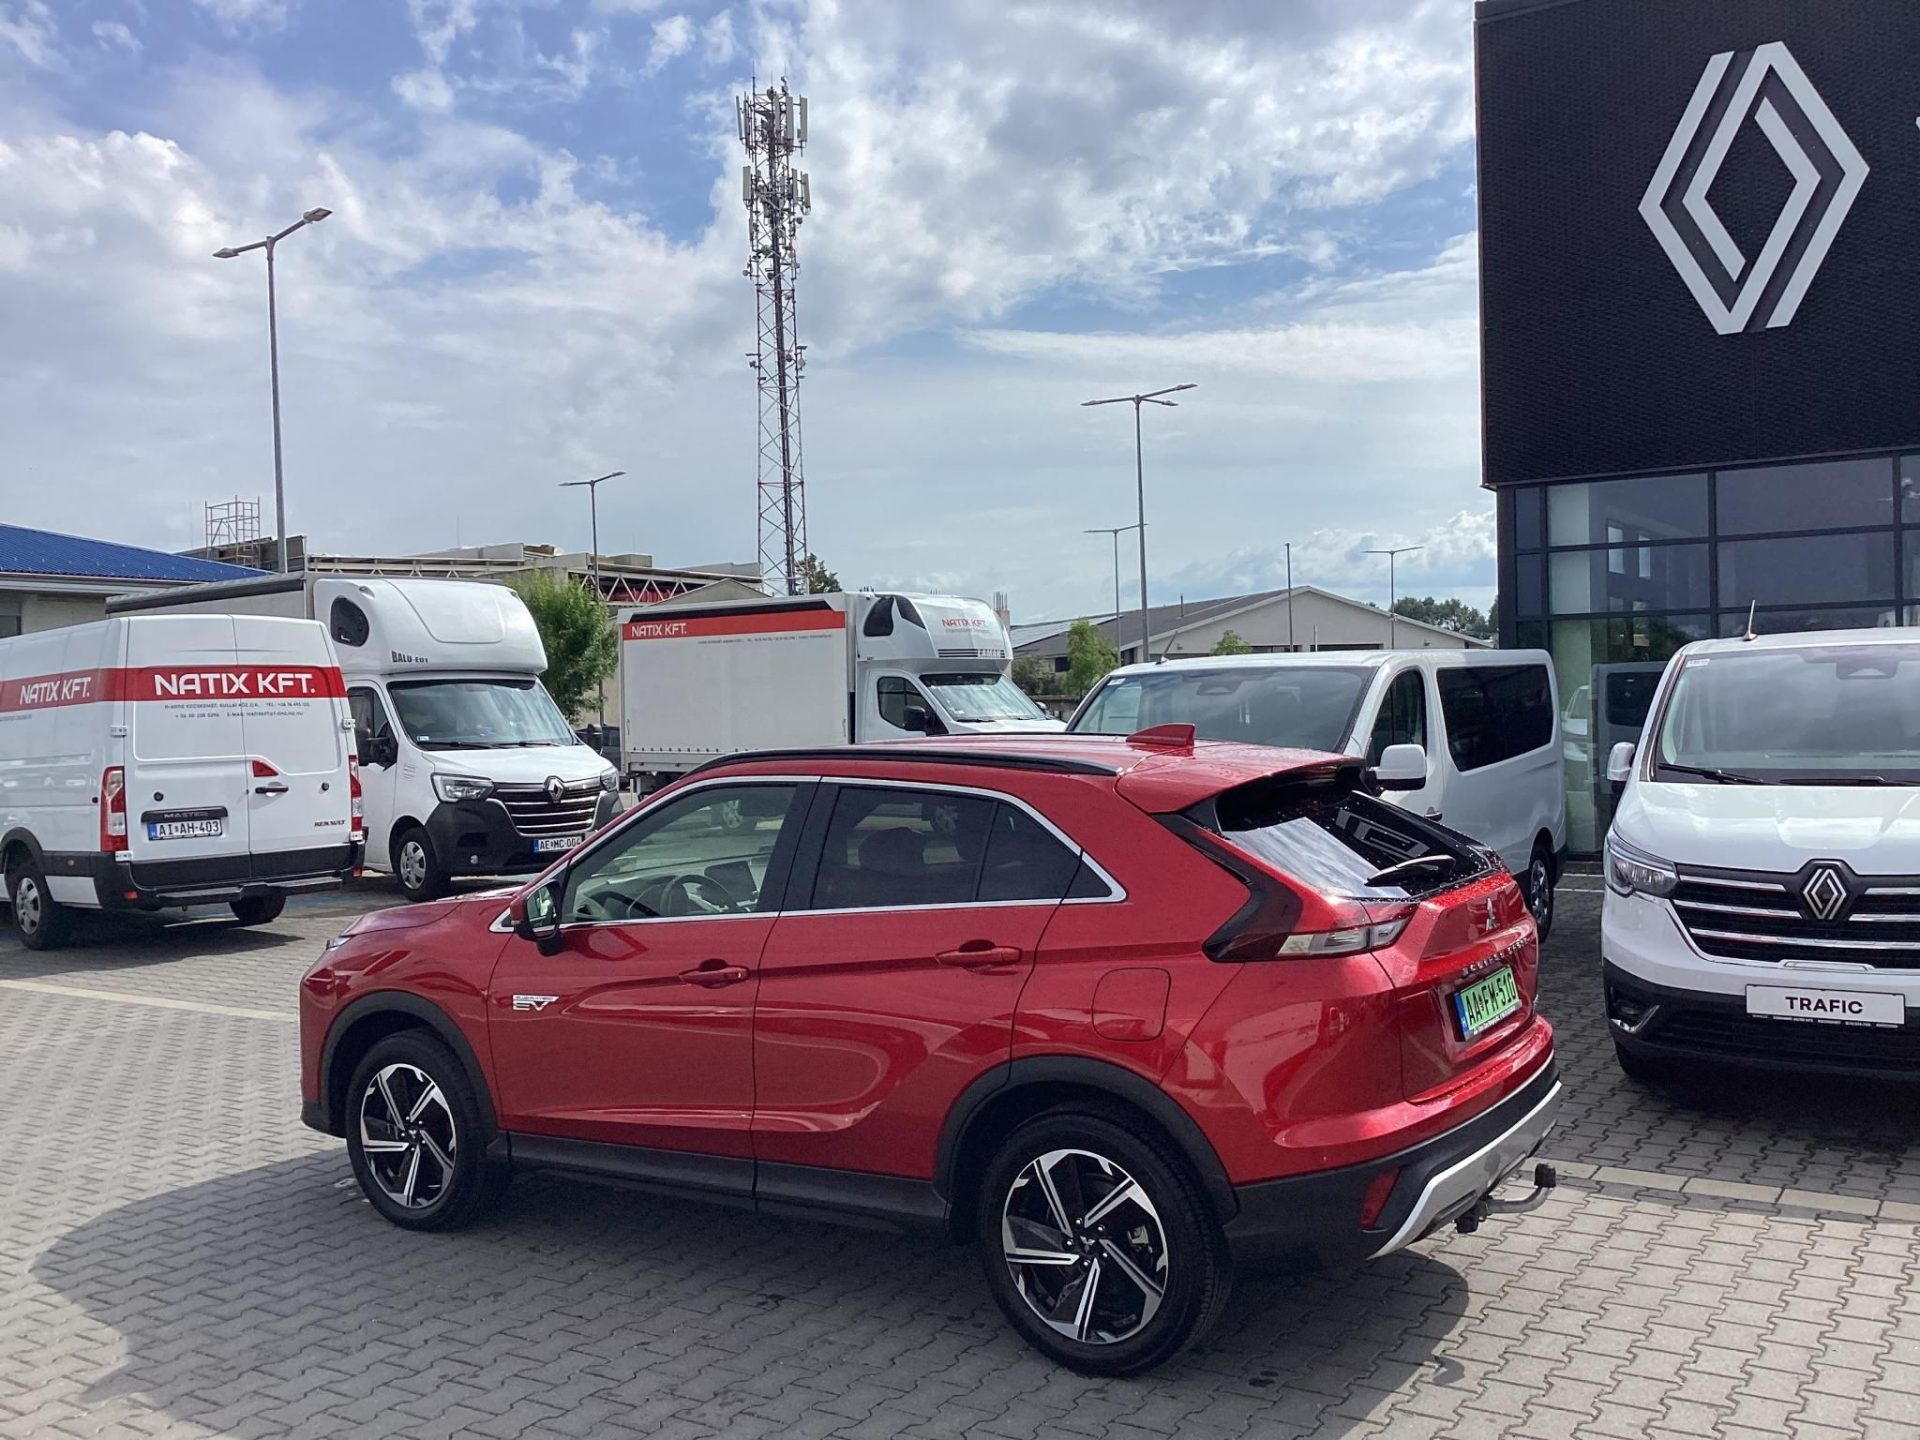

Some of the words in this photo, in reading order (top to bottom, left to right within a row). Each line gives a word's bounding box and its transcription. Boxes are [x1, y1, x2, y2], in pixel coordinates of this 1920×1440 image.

[631, 624, 662, 637] NATIX
[665, 623, 687, 635] KFT.
[20, 681, 60, 704] NATIX
[61, 677, 91, 700] KFT.
[154, 673, 250, 695] NATIX
[257, 672, 315, 694] KFT.
[1785, 996, 1863, 1014] TRAFIC
